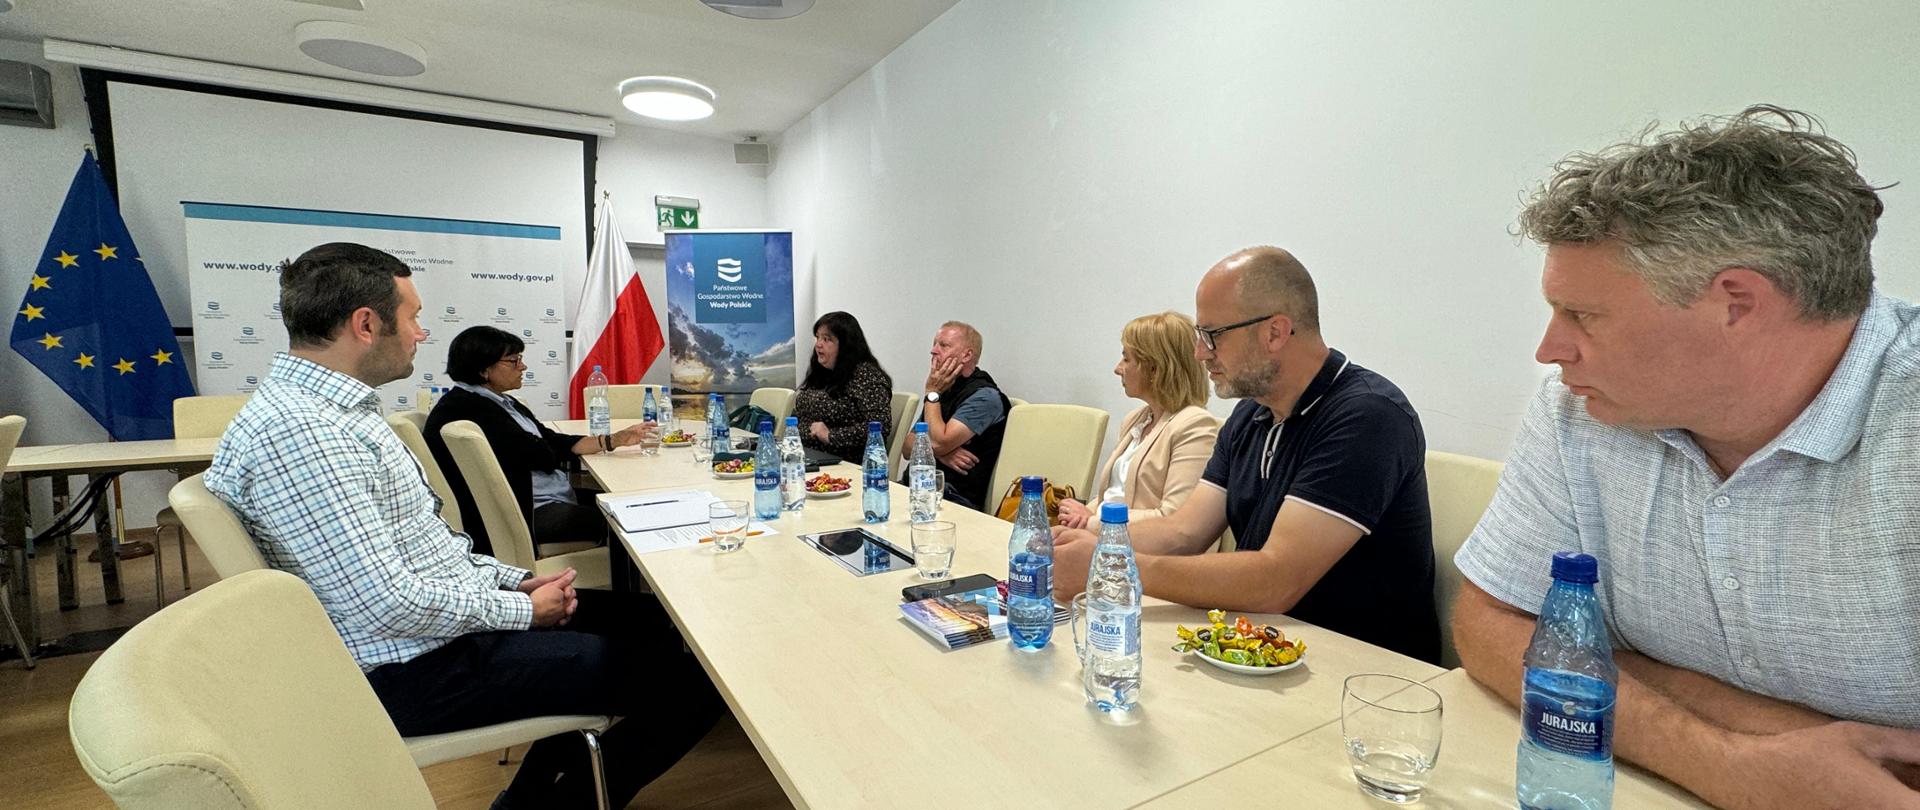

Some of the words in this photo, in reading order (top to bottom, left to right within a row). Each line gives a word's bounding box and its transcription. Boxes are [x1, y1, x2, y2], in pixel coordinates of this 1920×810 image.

[203, 262, 283, 273] www.wody.g
[471, 272, 554, 283] www.wody.gov.pl
[710, 301, 728, 309] Wody
[1541, 711, 1596, 735] JURAJSKA
